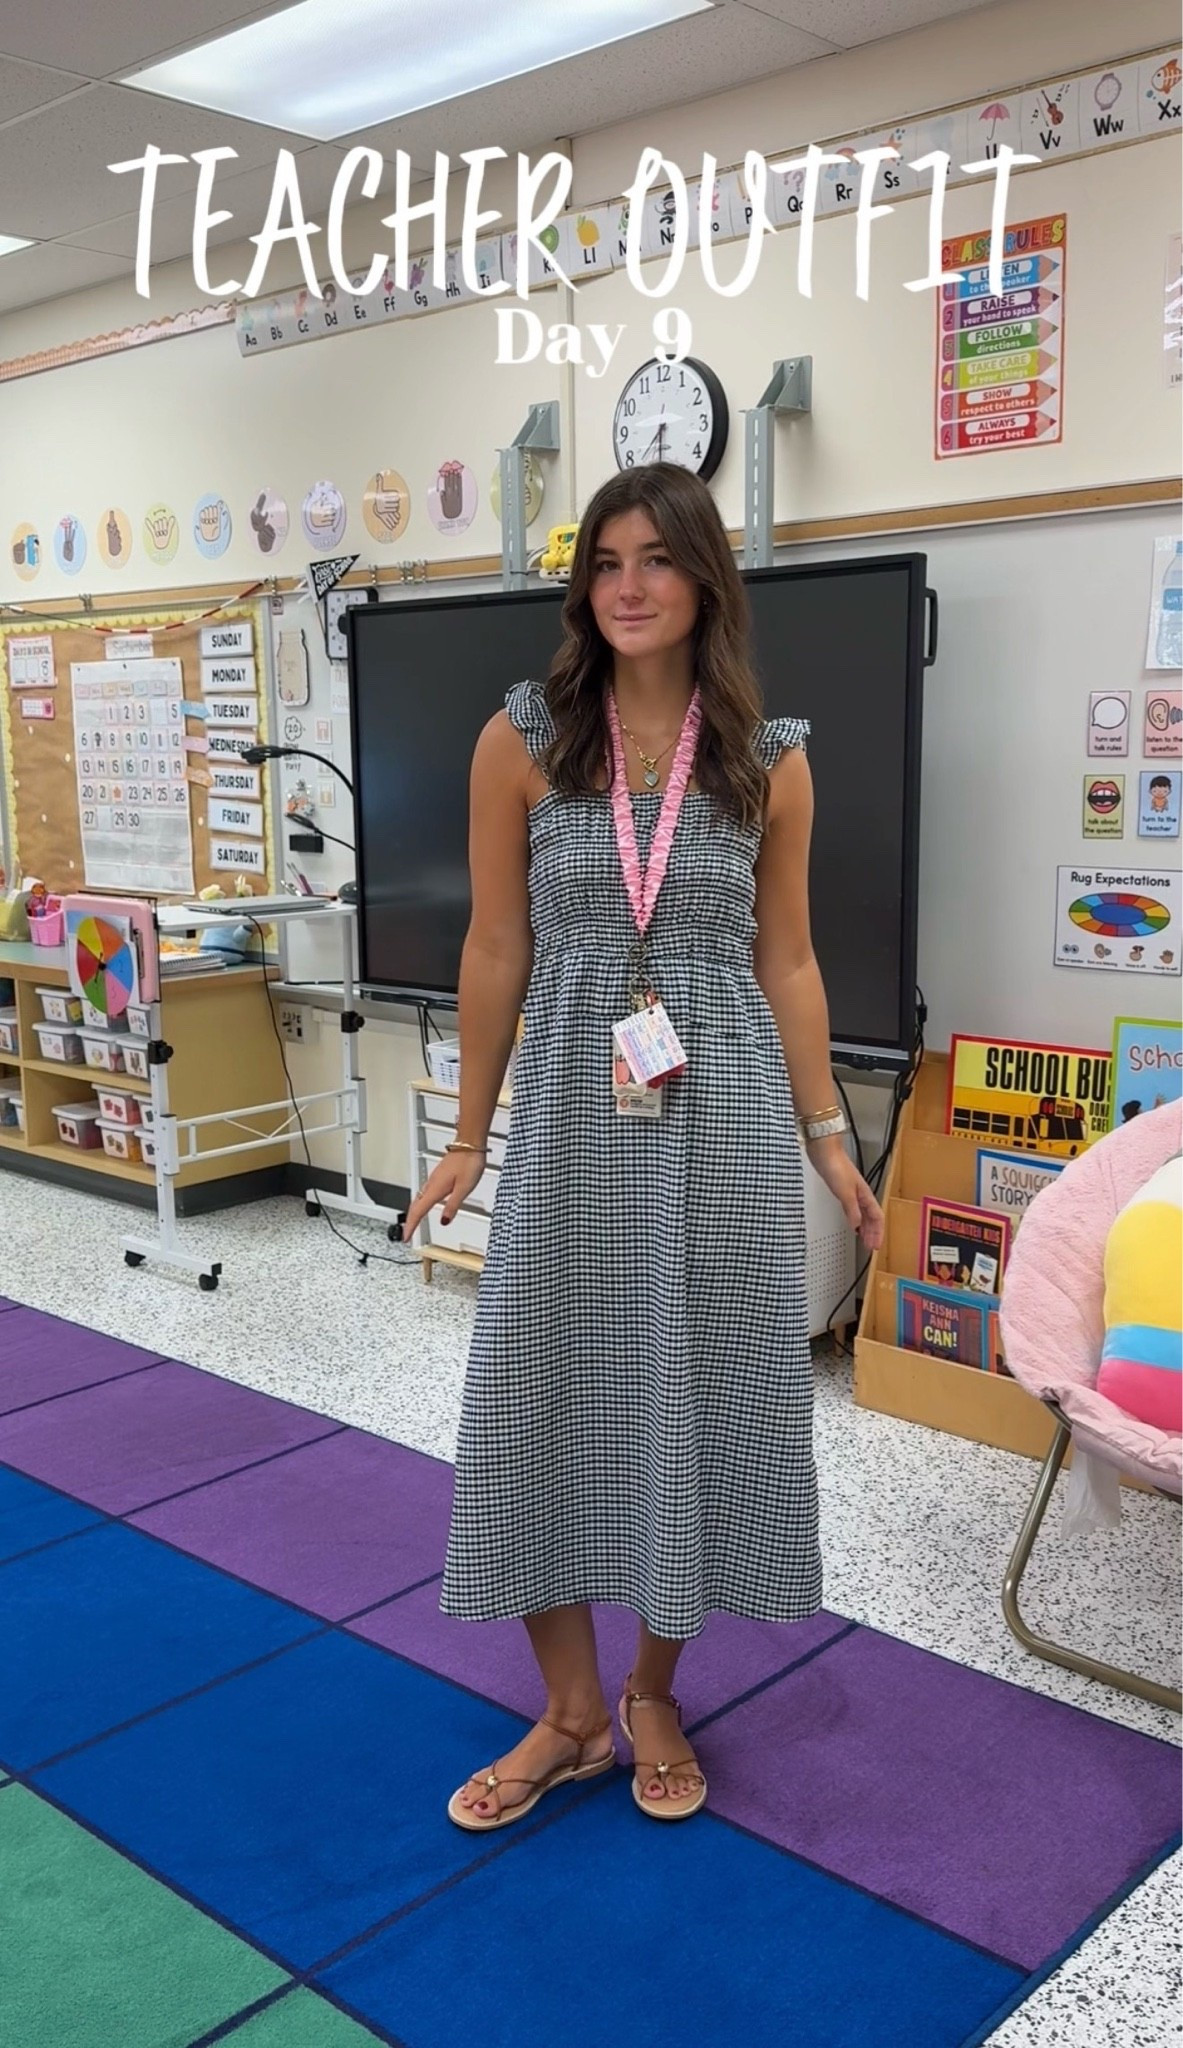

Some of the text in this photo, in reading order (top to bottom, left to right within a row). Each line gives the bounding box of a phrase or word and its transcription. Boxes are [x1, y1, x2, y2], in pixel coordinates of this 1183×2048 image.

[245, 334, 258, 346] Aa
[270, 327, 282, 340] Bb
[298, 320, 309, 333] Cc
[324, 311, 338, 326] Dd
[354, 305, 366, 320] Ee
[384, 297, 396, 312] Ff
[414, 290, 428, 306] Gg
[446, 282, 460, 298] Hh
[479, 274, 490, 289] Ii
[583, 247, 596, 264] Ll
[835, 182, 853, 202] Rr
[884, 171, 900, 188] Ss
[1040, 130, 1061, 150] Vv
[1094, 114, 1124, 138] Ww
[1157, 99, 1182, 120] Xx
[1004, 219, 1065, 253] RULES
[980, 295, 1016, 311] RAISE
[944, 310, 953, 325] 2
[964, 304, 1036, 326] your hand to speak
[975, 324, 1023, 342] FOLLOW
[976, 340, 1021, 354] directions
[971, 355, 1028, 373] TAKE CARE
[656, 364, 671, 383] 12
[680, 370, 686, 388] 1
[944, 370, 952, 386] 4
[640, 376, 650, 394] 11
[693, 387, 702, 406] 2
[983, 388, 1012, 400] SHOW
[624, 398, 636, 417] 10
[960, 399, 1035, 417] respect to others
[699, 414, 708, 432] 3
[978, 418, 1016, 431] ALWAYS
[620, 426, 628, 444] 9
[944, 430, 952, 446] 6
[970, 430, 1025, 445] try your best
[692, 441, 702, 458] 4
[626, 450, 634, 468] 8
[212, 632, 242, 648] SUNDAY
[212, 668, 246, 682] MONDAY
[124, 706, 130, 720] 2
[139, 705, 144, 720] 3
[172, 704, 178, 718] 5
[212, 704, 250, 718] TUESDAY
[82, 732, 88, 746] 6
[110, 732, 116, 746] 8
[126, 732, 132, 746] 9
[140, 732, 148, 746] 10
[172, 733, 180, 746] 12
[82, 760, 90, 774] 13
[112, 760, 120, 774] 15
[126, 760, 134, 772] 16
[142, 760, 150, 772] 17
[158, 760, 166, 774] 18
[174, 760, 182, 774] 19
[214, 774, 254, 789] THURSDAY
[82, 784, 94, 798] 20
[128, 786, 138, 800] 23
[142, 786, 152, 800] 24
[157, 787, 168, 801] 25
[174, 788, 186, 802] 26
[84, 811, 140, 827] 27 29 30
[222, 808, 250, 824] FRIDAY
[217, 848, 258, 864] SATURDAY
[1070, 871, 1170, 886] Rug Expectations
[985, 1047, 1070, 1098] SCHOOL
[991, 1166, 998, 1180] A
[991, 1184, 1033, 1206] STORY
[922, 1299, 959, 1321] KEISHA
[930, 1314, 952, 1330] ANN
[924, 1326, 958, 1348] CAN!
